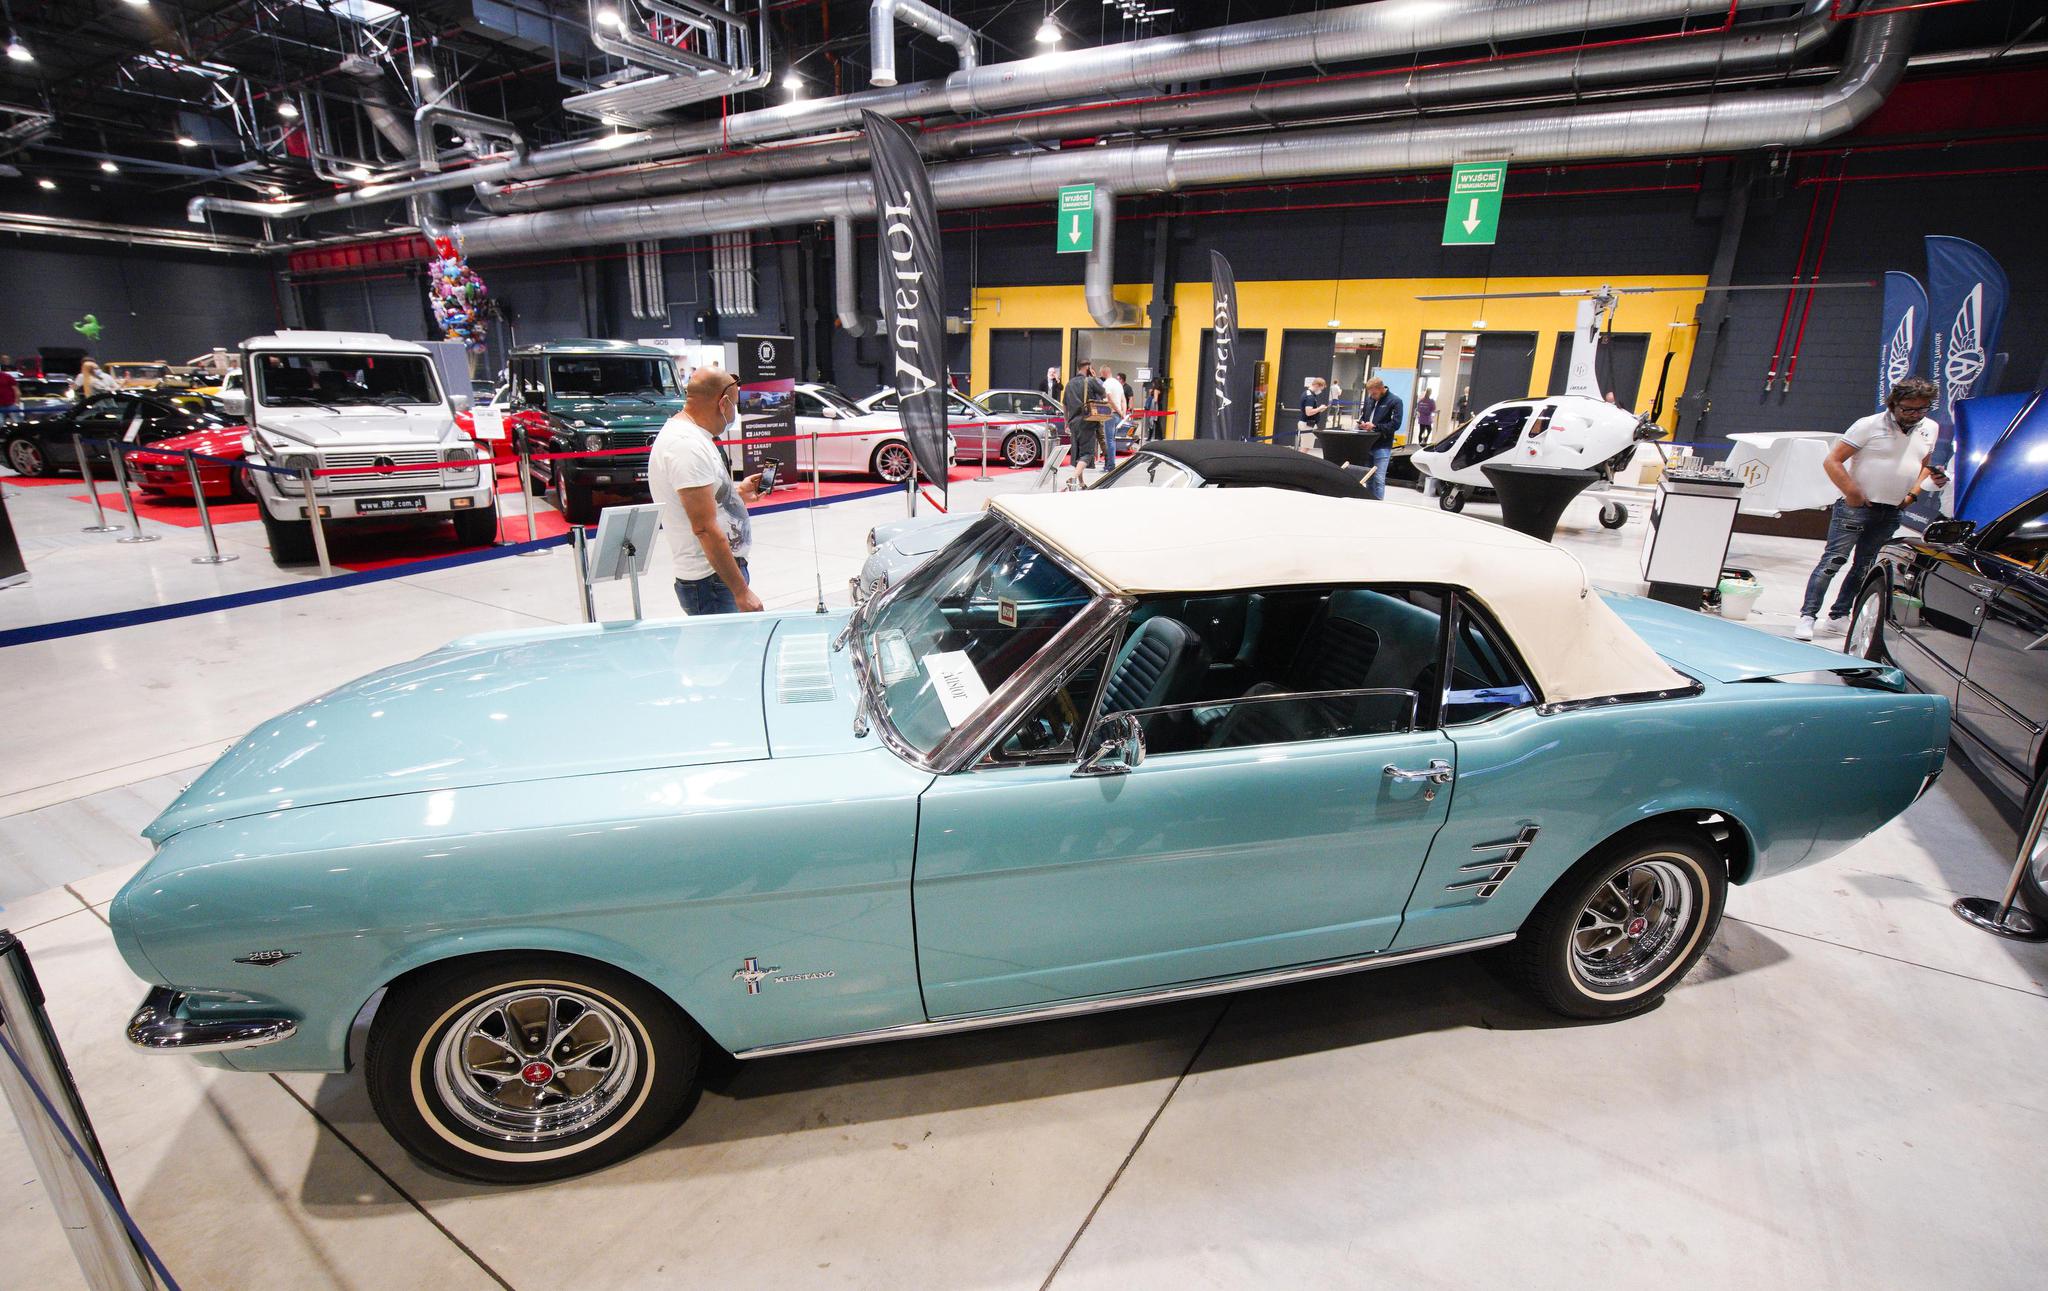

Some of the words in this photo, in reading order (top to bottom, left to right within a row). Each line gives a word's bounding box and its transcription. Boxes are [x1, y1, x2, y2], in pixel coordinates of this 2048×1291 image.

[1461, 173, 1497, 182] WYJŚCIE
[249, 950, 283, 960] 289
[774, 970, 836, 984] MUSTANG
